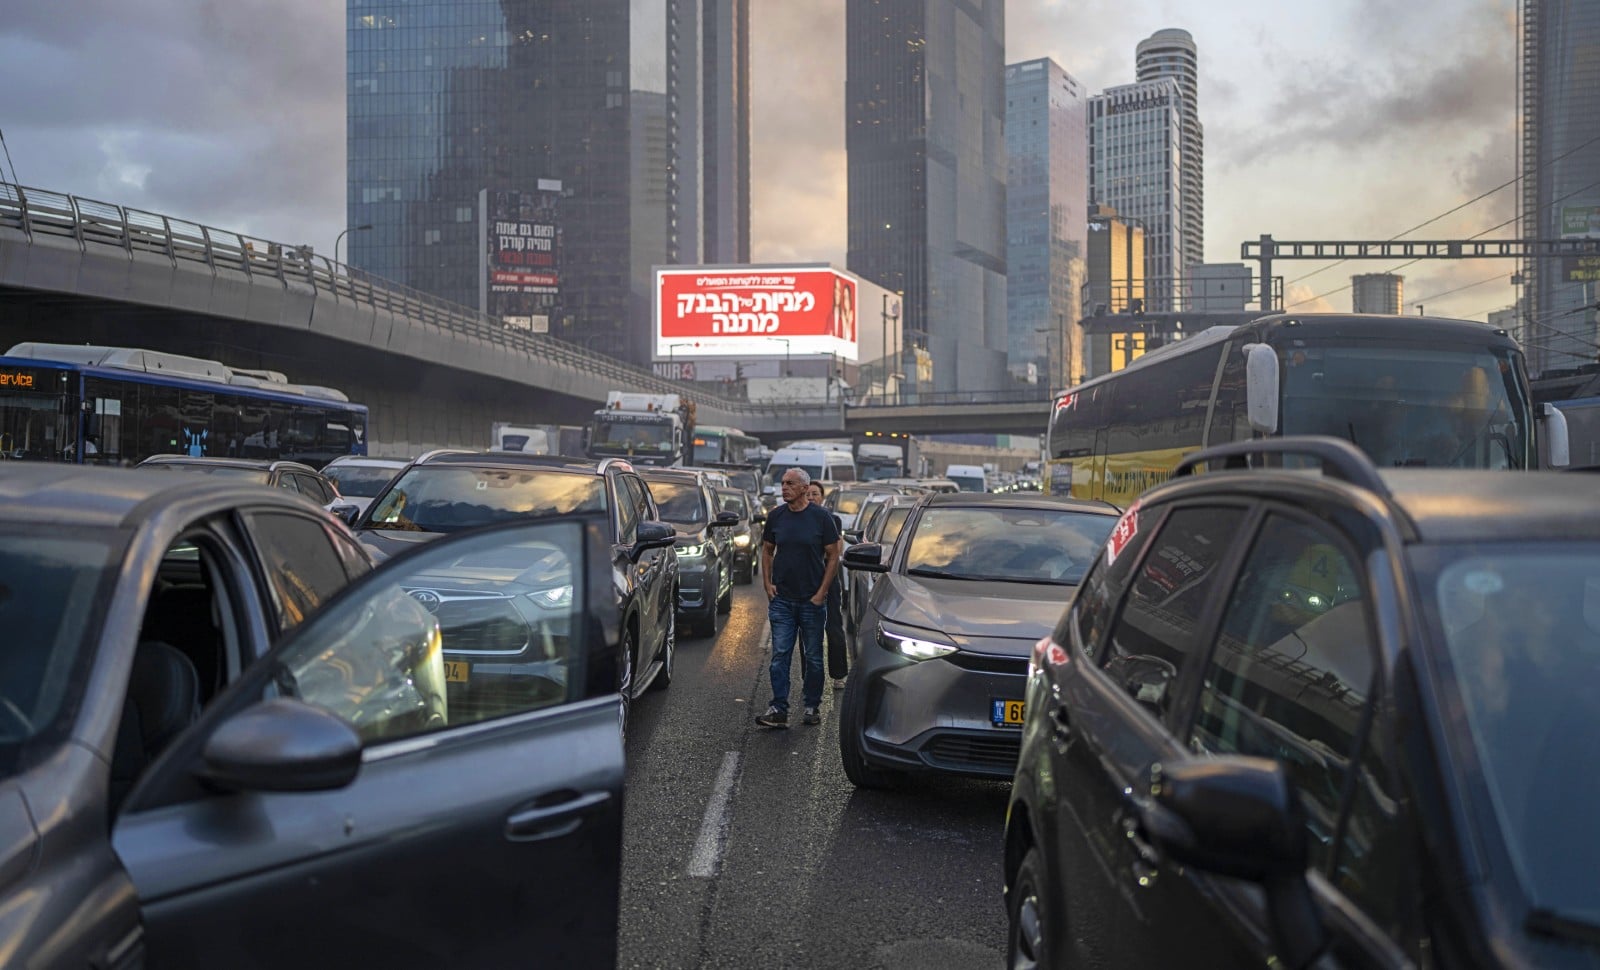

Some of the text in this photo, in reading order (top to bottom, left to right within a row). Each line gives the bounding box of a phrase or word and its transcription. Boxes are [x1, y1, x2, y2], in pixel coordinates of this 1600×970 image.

[497, 222, 554, 238] האם גם אתה
[500, 236, 525, 251] קורבן
[696, 276, 728, 286] הפועלים
[729, 275, 760, 287] ללקוחות
[677, 291, 739, 319] הבנק
[754, 291, 815, 312] מניות
[712, 312, 780, 334] מתנה
[0, 372, 33, 386] ervice
